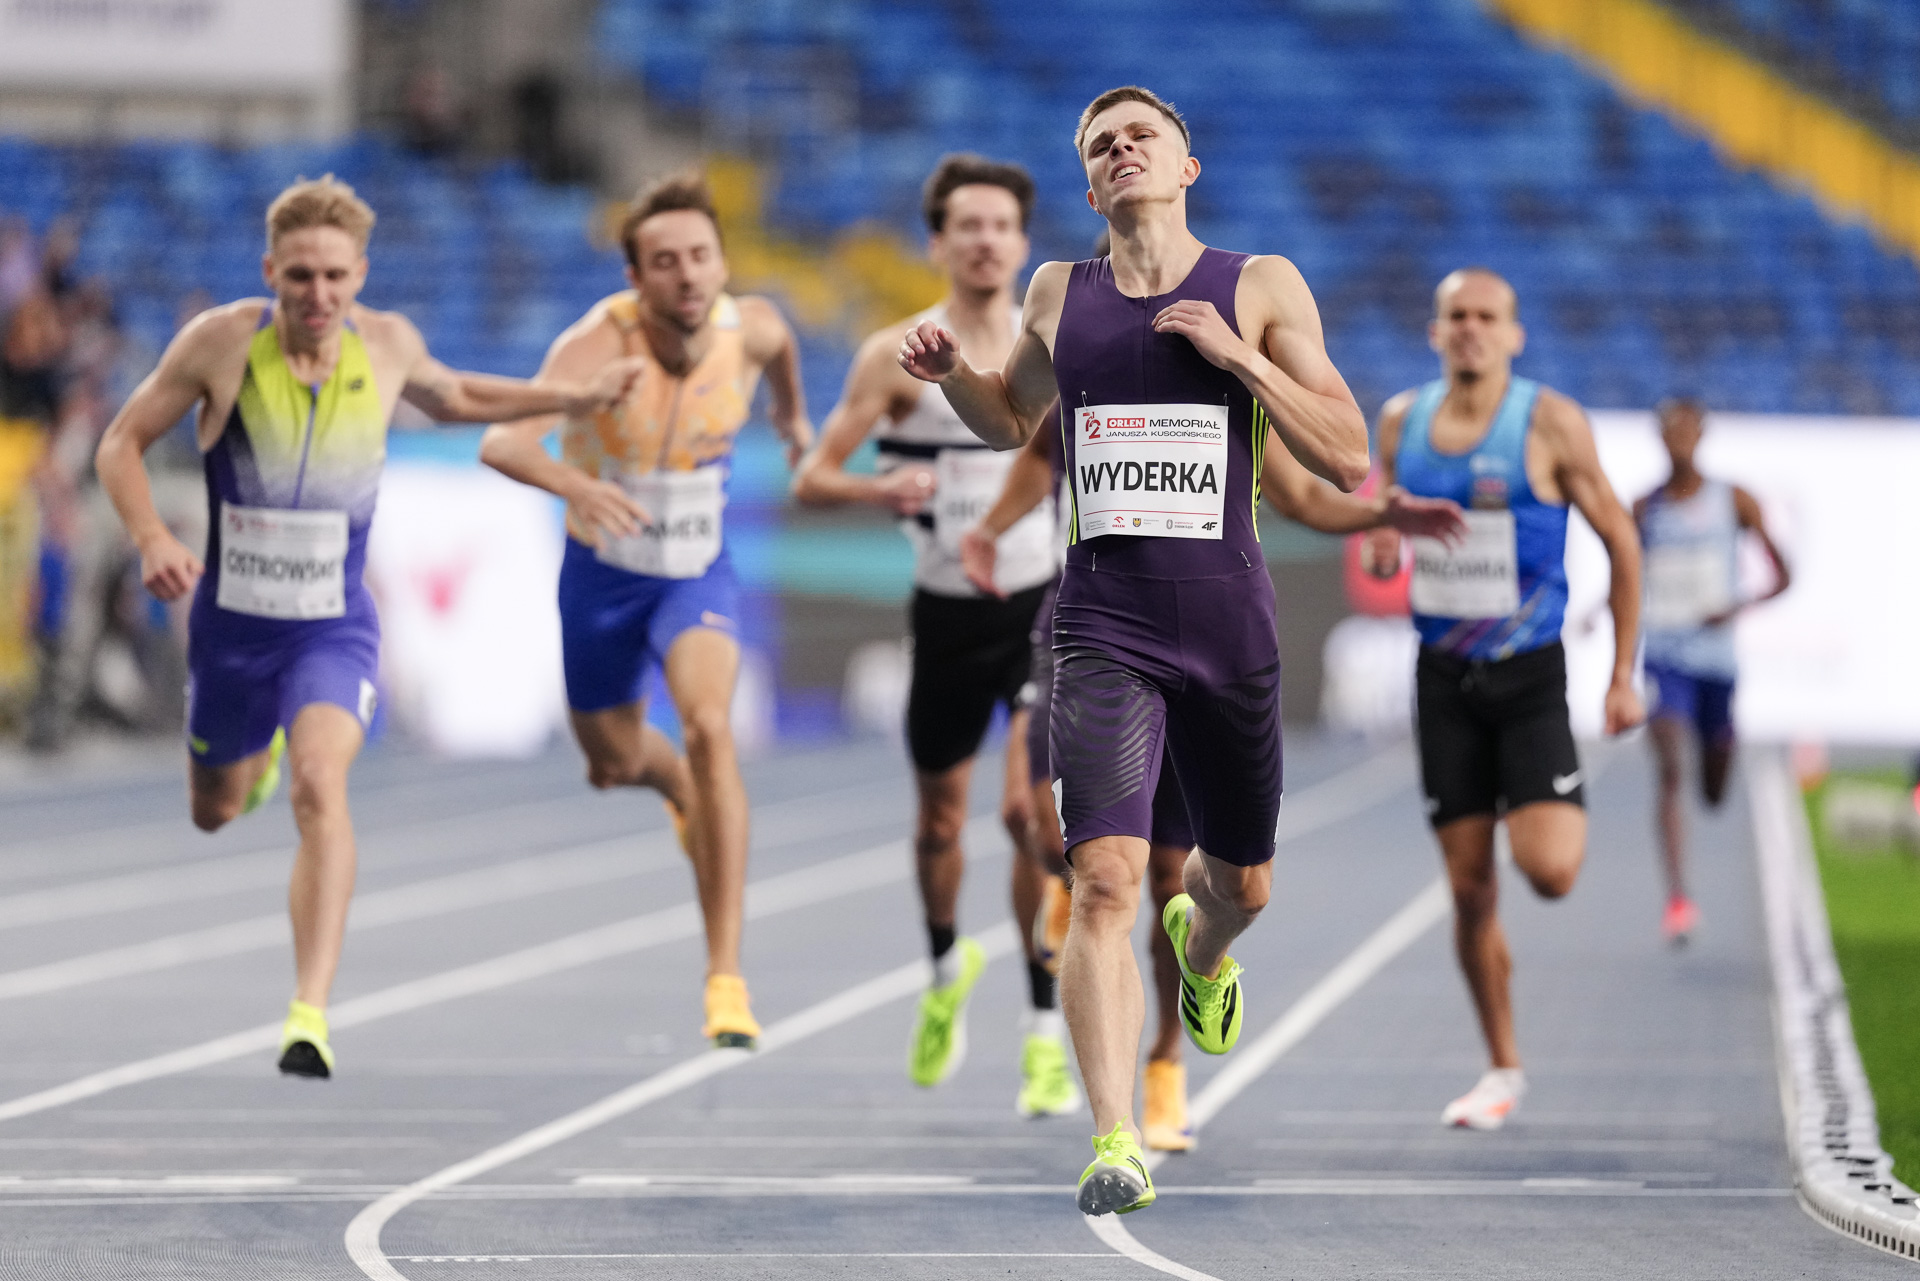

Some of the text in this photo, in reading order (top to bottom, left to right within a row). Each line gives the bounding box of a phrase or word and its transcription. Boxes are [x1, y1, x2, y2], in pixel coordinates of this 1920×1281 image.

[1108, 418, 1221, 430] ORLEN MEMORIAŁ
[1106, 430, 1222, 439] JANUSZA KUSOCIŃSKIEGO
[1080, 461, 1218, 495] WYDERKA
[1201, 521, 1218, 531] 4F
